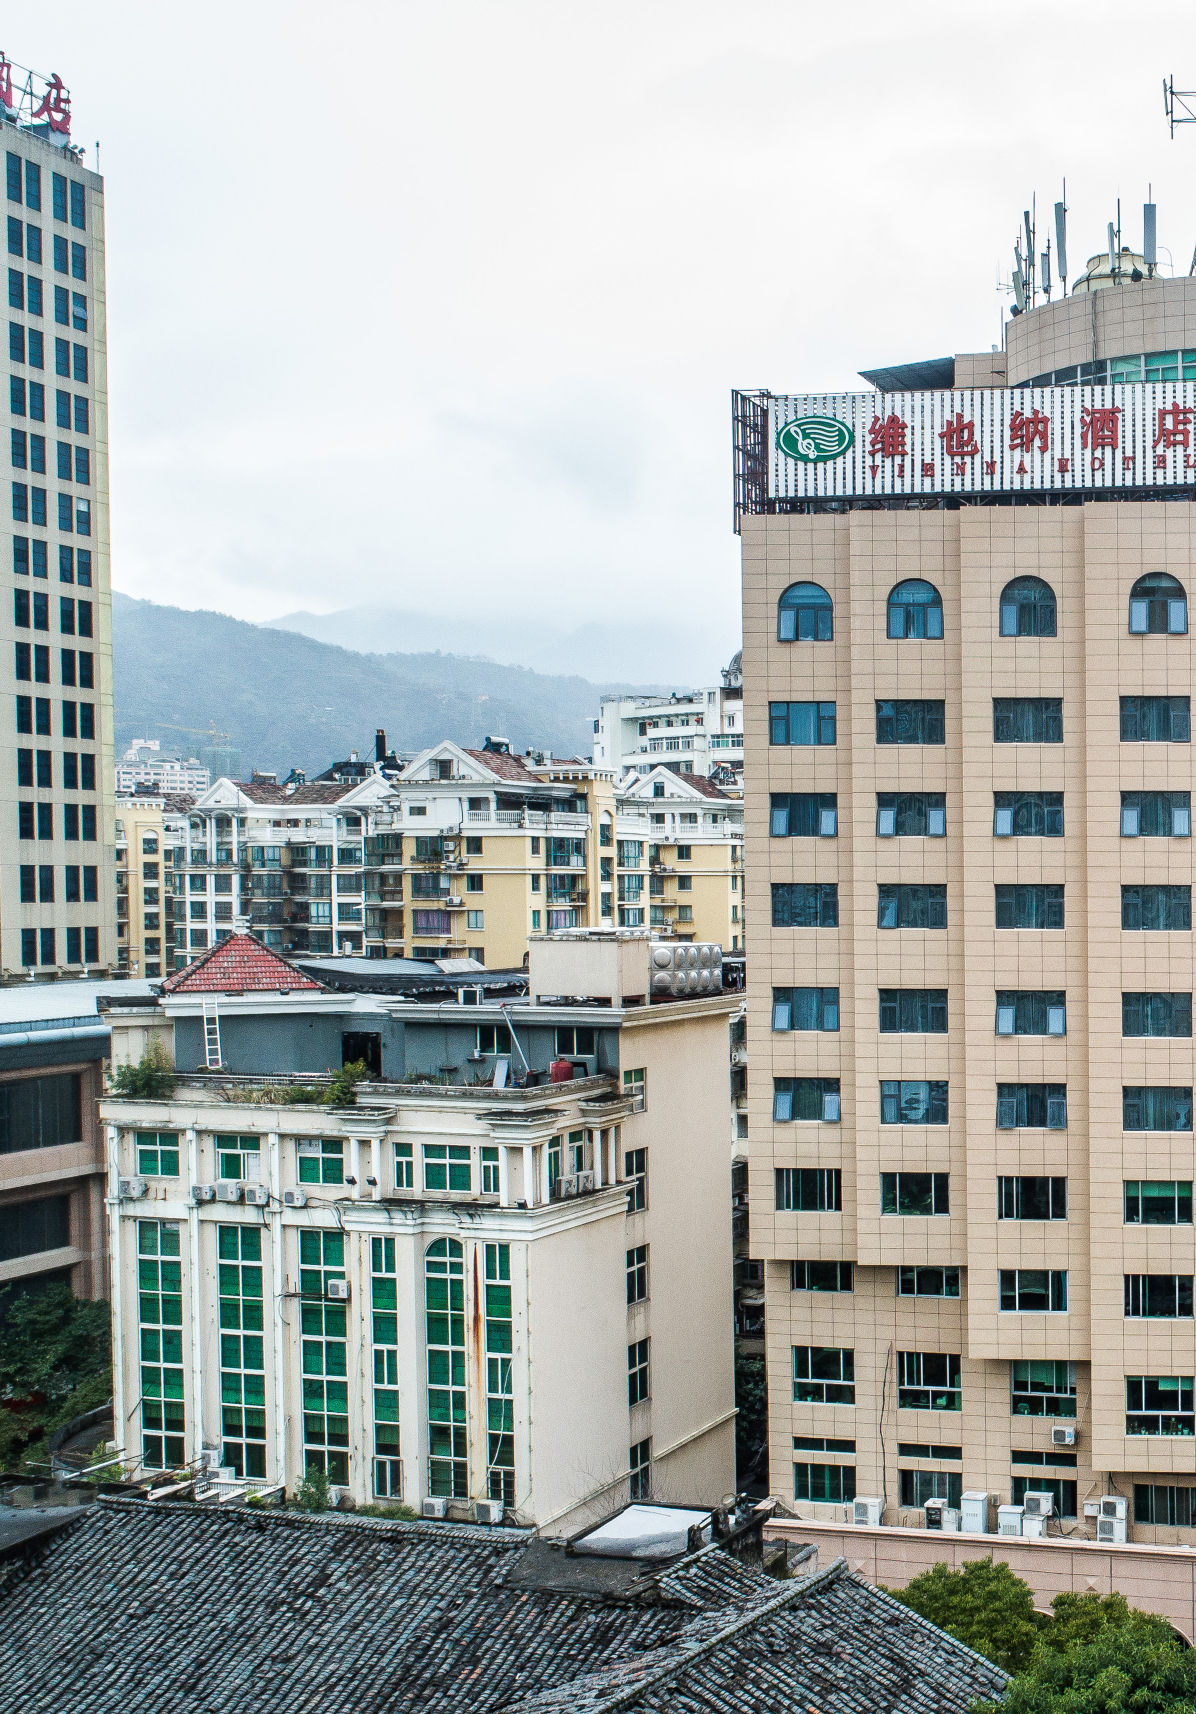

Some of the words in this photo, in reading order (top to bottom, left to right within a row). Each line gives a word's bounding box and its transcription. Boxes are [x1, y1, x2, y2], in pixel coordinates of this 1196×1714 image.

[867, 402, 1195, 458] 维也纳酒店
[868, 457, 1028, 479] VIENNA
[1057, 452, 1196, 473] HOTEL
